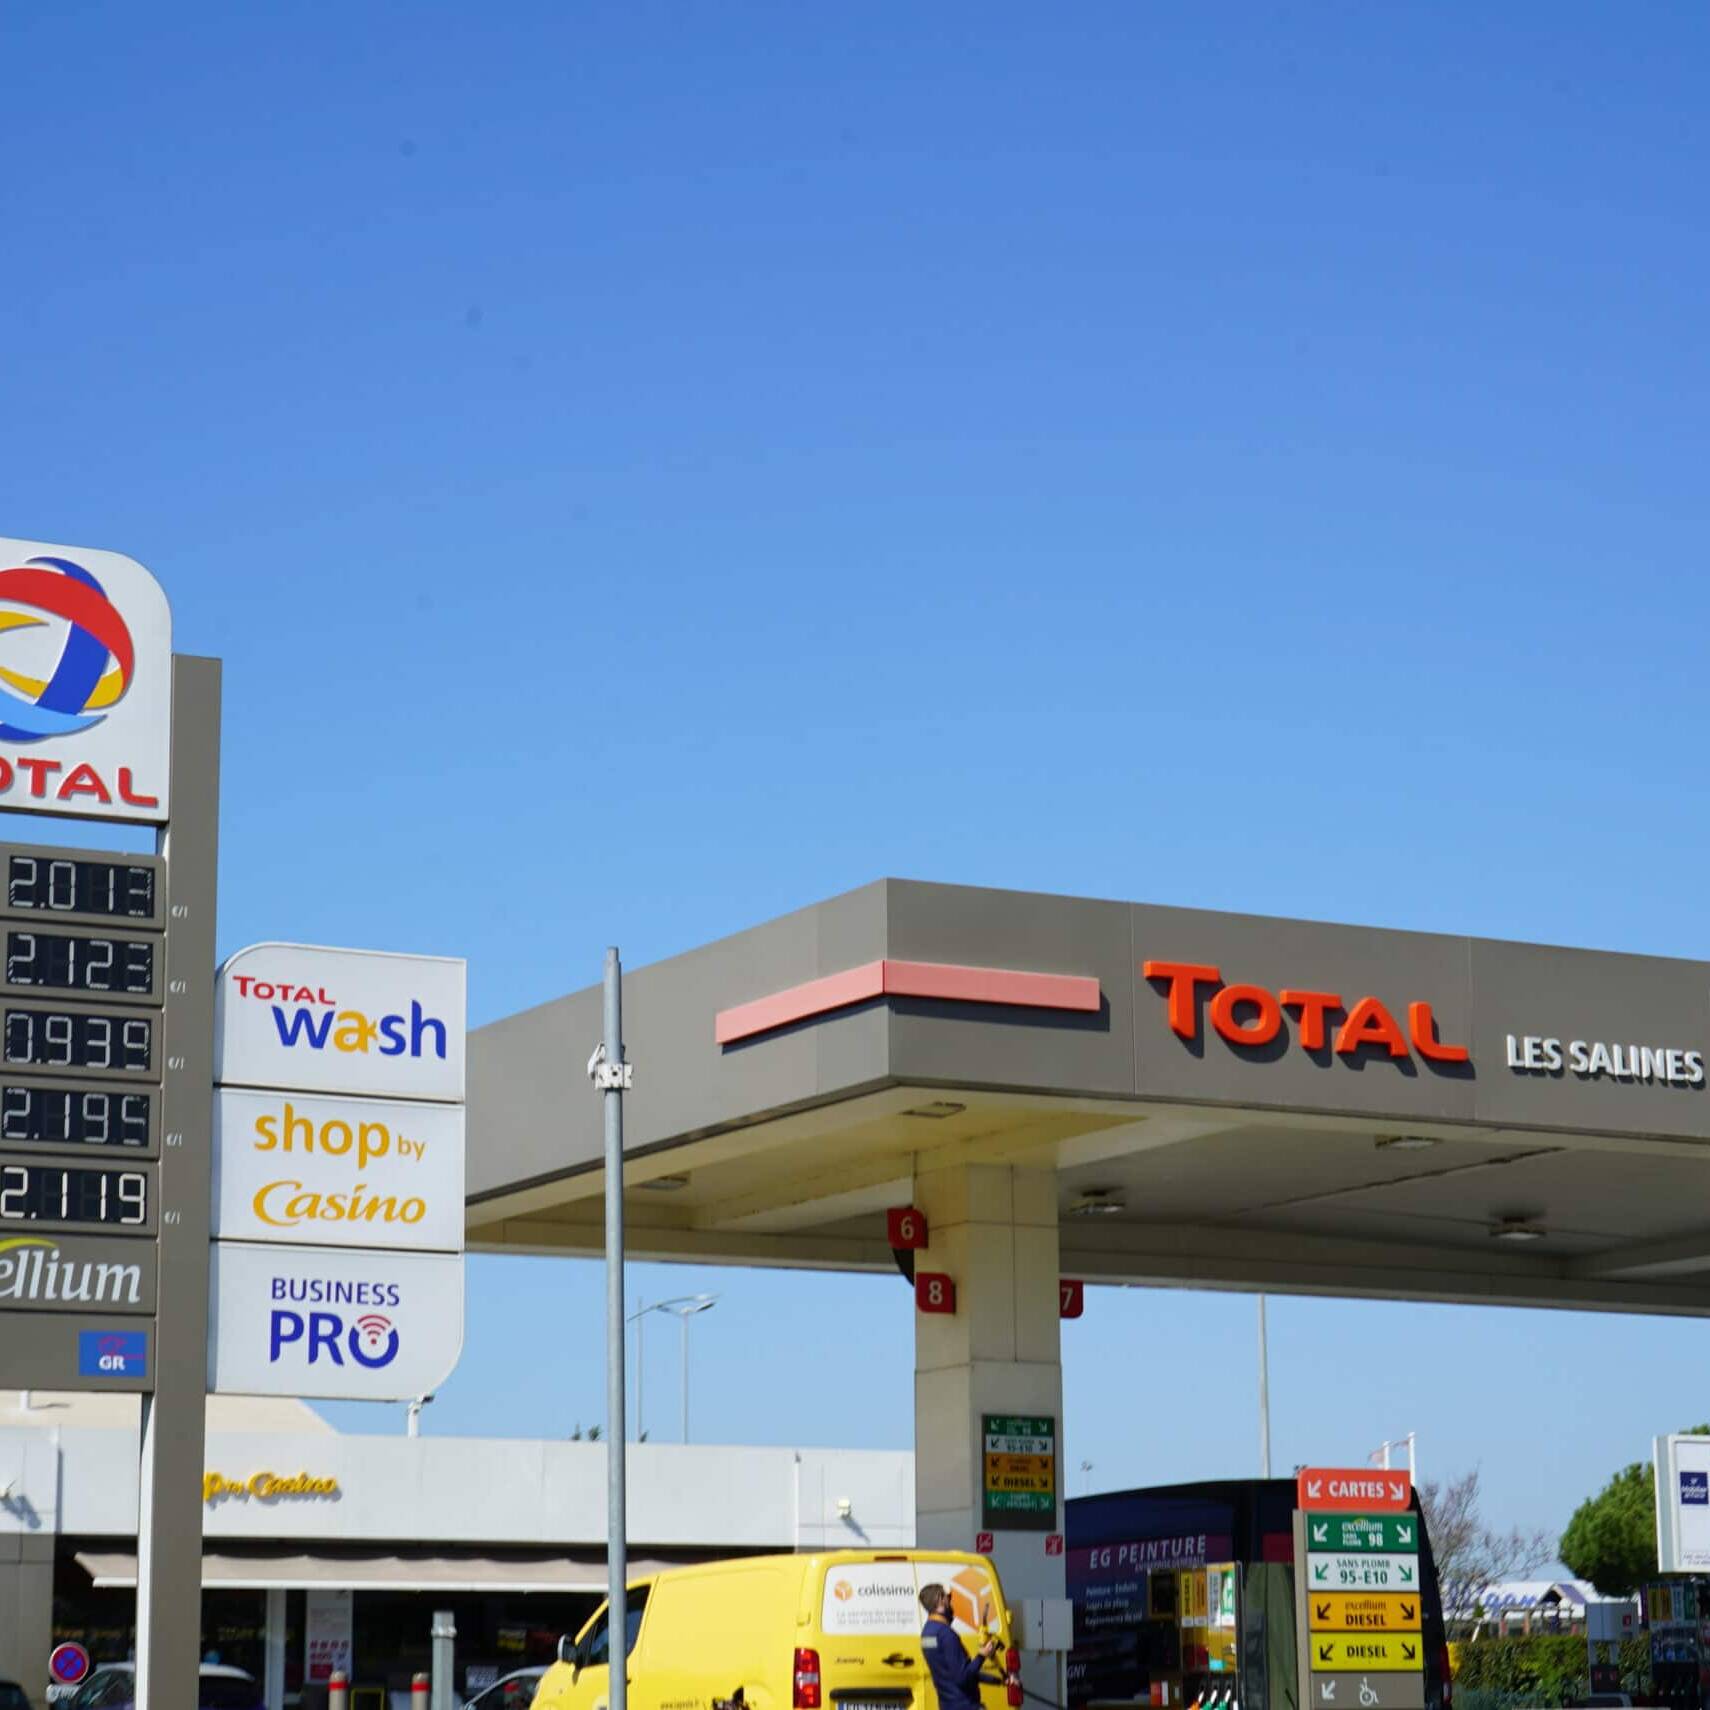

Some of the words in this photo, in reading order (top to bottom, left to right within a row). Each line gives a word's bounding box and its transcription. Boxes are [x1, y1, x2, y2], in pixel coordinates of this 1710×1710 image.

[9, 858, 153, 916] 2.013
[233, 975, 336, 1006] TOTAL
[1143, 960, 1469, 1063] TOTAL
[1506, 1034, 1562, 1070] LES
[1569, 1040, 1704, 1082] SALINES
[254, 1102, 390, 1170] shop
[397, 1134, 425, 1161] by
[0, 1166, 146, 1224] 2.119
[253, 1180, 427, 1227] Casino
[900, 1216, 914, 1240] 6
[271, 1276, 400, 1307] BUSINESS
[928, 1280, 943, 1305] 8
[1061, 1287, 1074, 1311] 7
[269, 1309, 400, 1369] PRO
[1329, 1480, 1385, 1498] CARTES
[1090, 1548, 1111, 1570] EG
[1118, 1534, 1207, 1564] PEINTURE
[1336, 1558, 1359, 1569] SANS
[1361, 1558, 1390, 1569] PLOMB
[857, 1583, 915, 1597] colissimo
[1340, 1570, 1388, 1585] 95-E10
[1345, 1614, 1387, 1627] DIESEL
[1346, 1645, 1388, 1659] DIESEL
